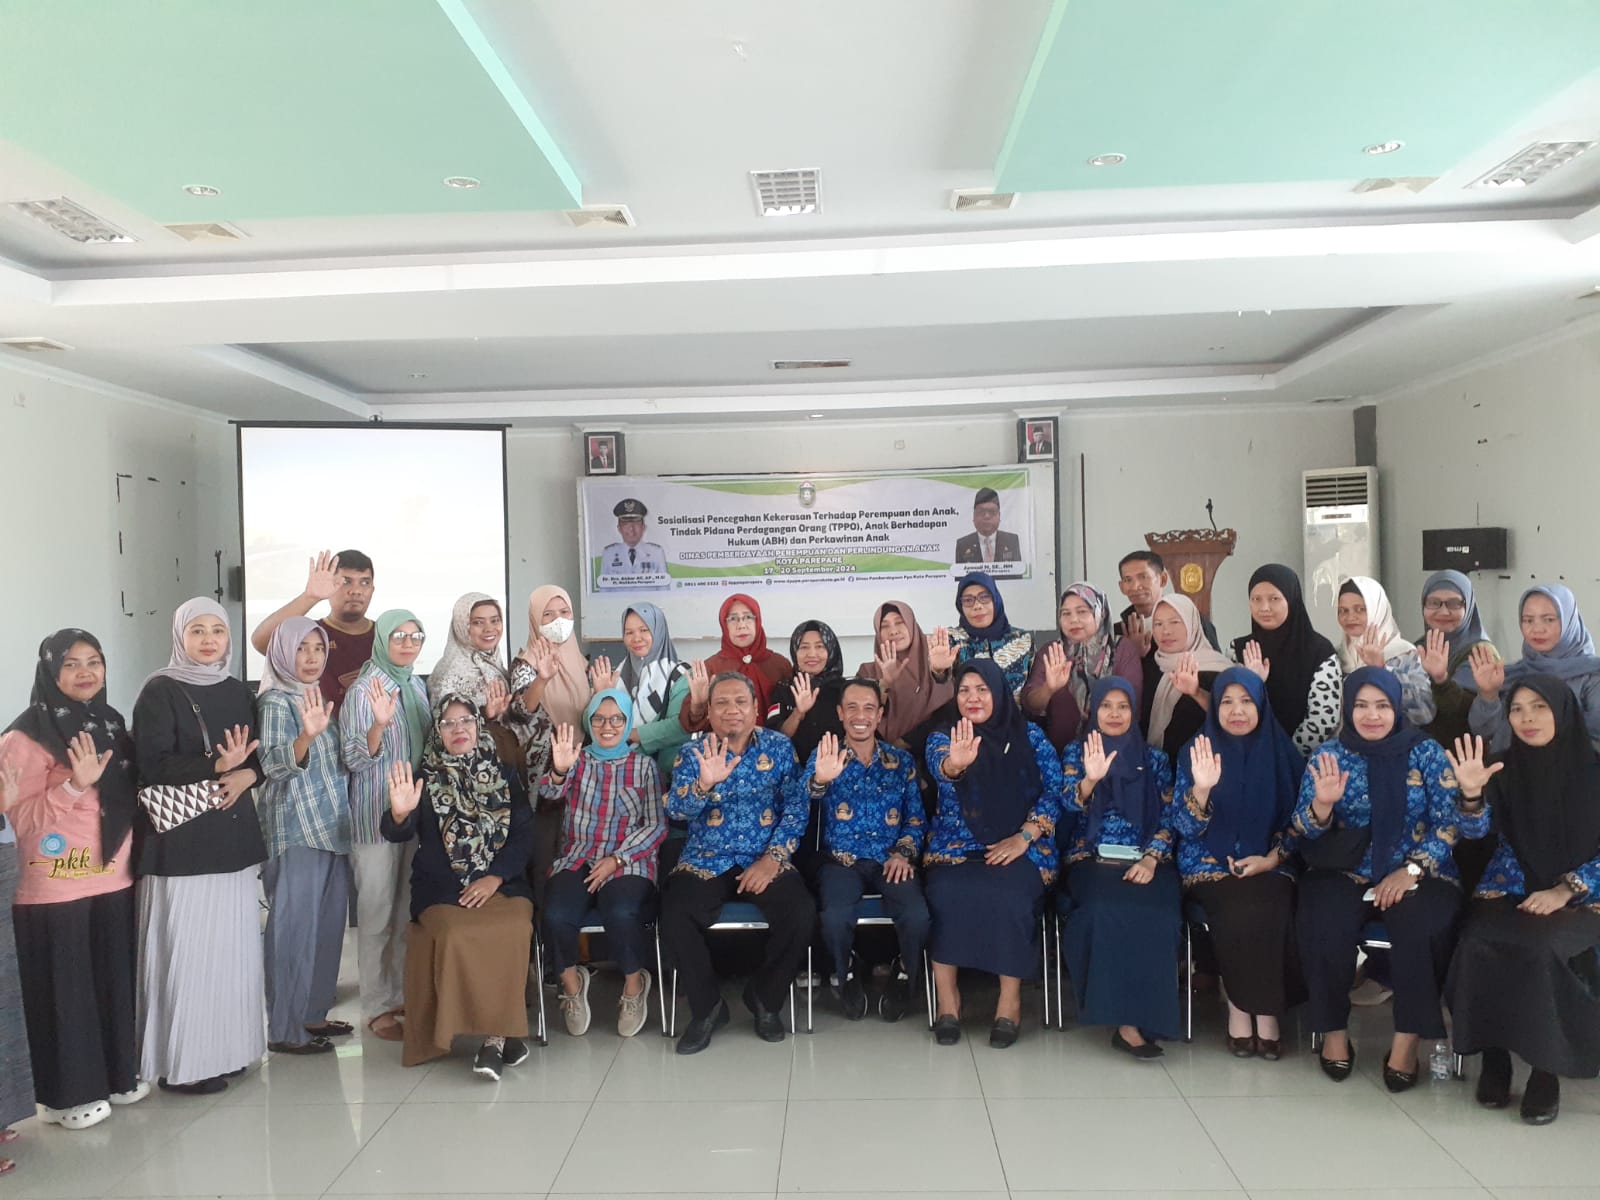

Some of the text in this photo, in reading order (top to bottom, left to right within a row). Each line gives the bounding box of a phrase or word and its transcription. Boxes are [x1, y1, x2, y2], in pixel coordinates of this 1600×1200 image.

[657, 507, 959, 525] Sosialisasi Pencegahan Kekerasan Terhadap Perempuan dan Anak,
[670, 519, 948, 536] Tindak Pidana Perdagangan Orang (TPPO), Anak Berhadapan
[727, 533, 890, 547] Hukum (ABH) dan Perkawinan Anak
[679, 544, 940, 560] DINAS PEMBERDAYAAN PEREMPUAN DAN PERLINDUNGAN ANAK
[775, 556, 843, 566] KOTA PAREPARE
[763, 567, 774, 575] 17
[781, 567, 791, 575] 20
[791, 566, 834, 576] September
[835, 565, 856, 573] 2024
